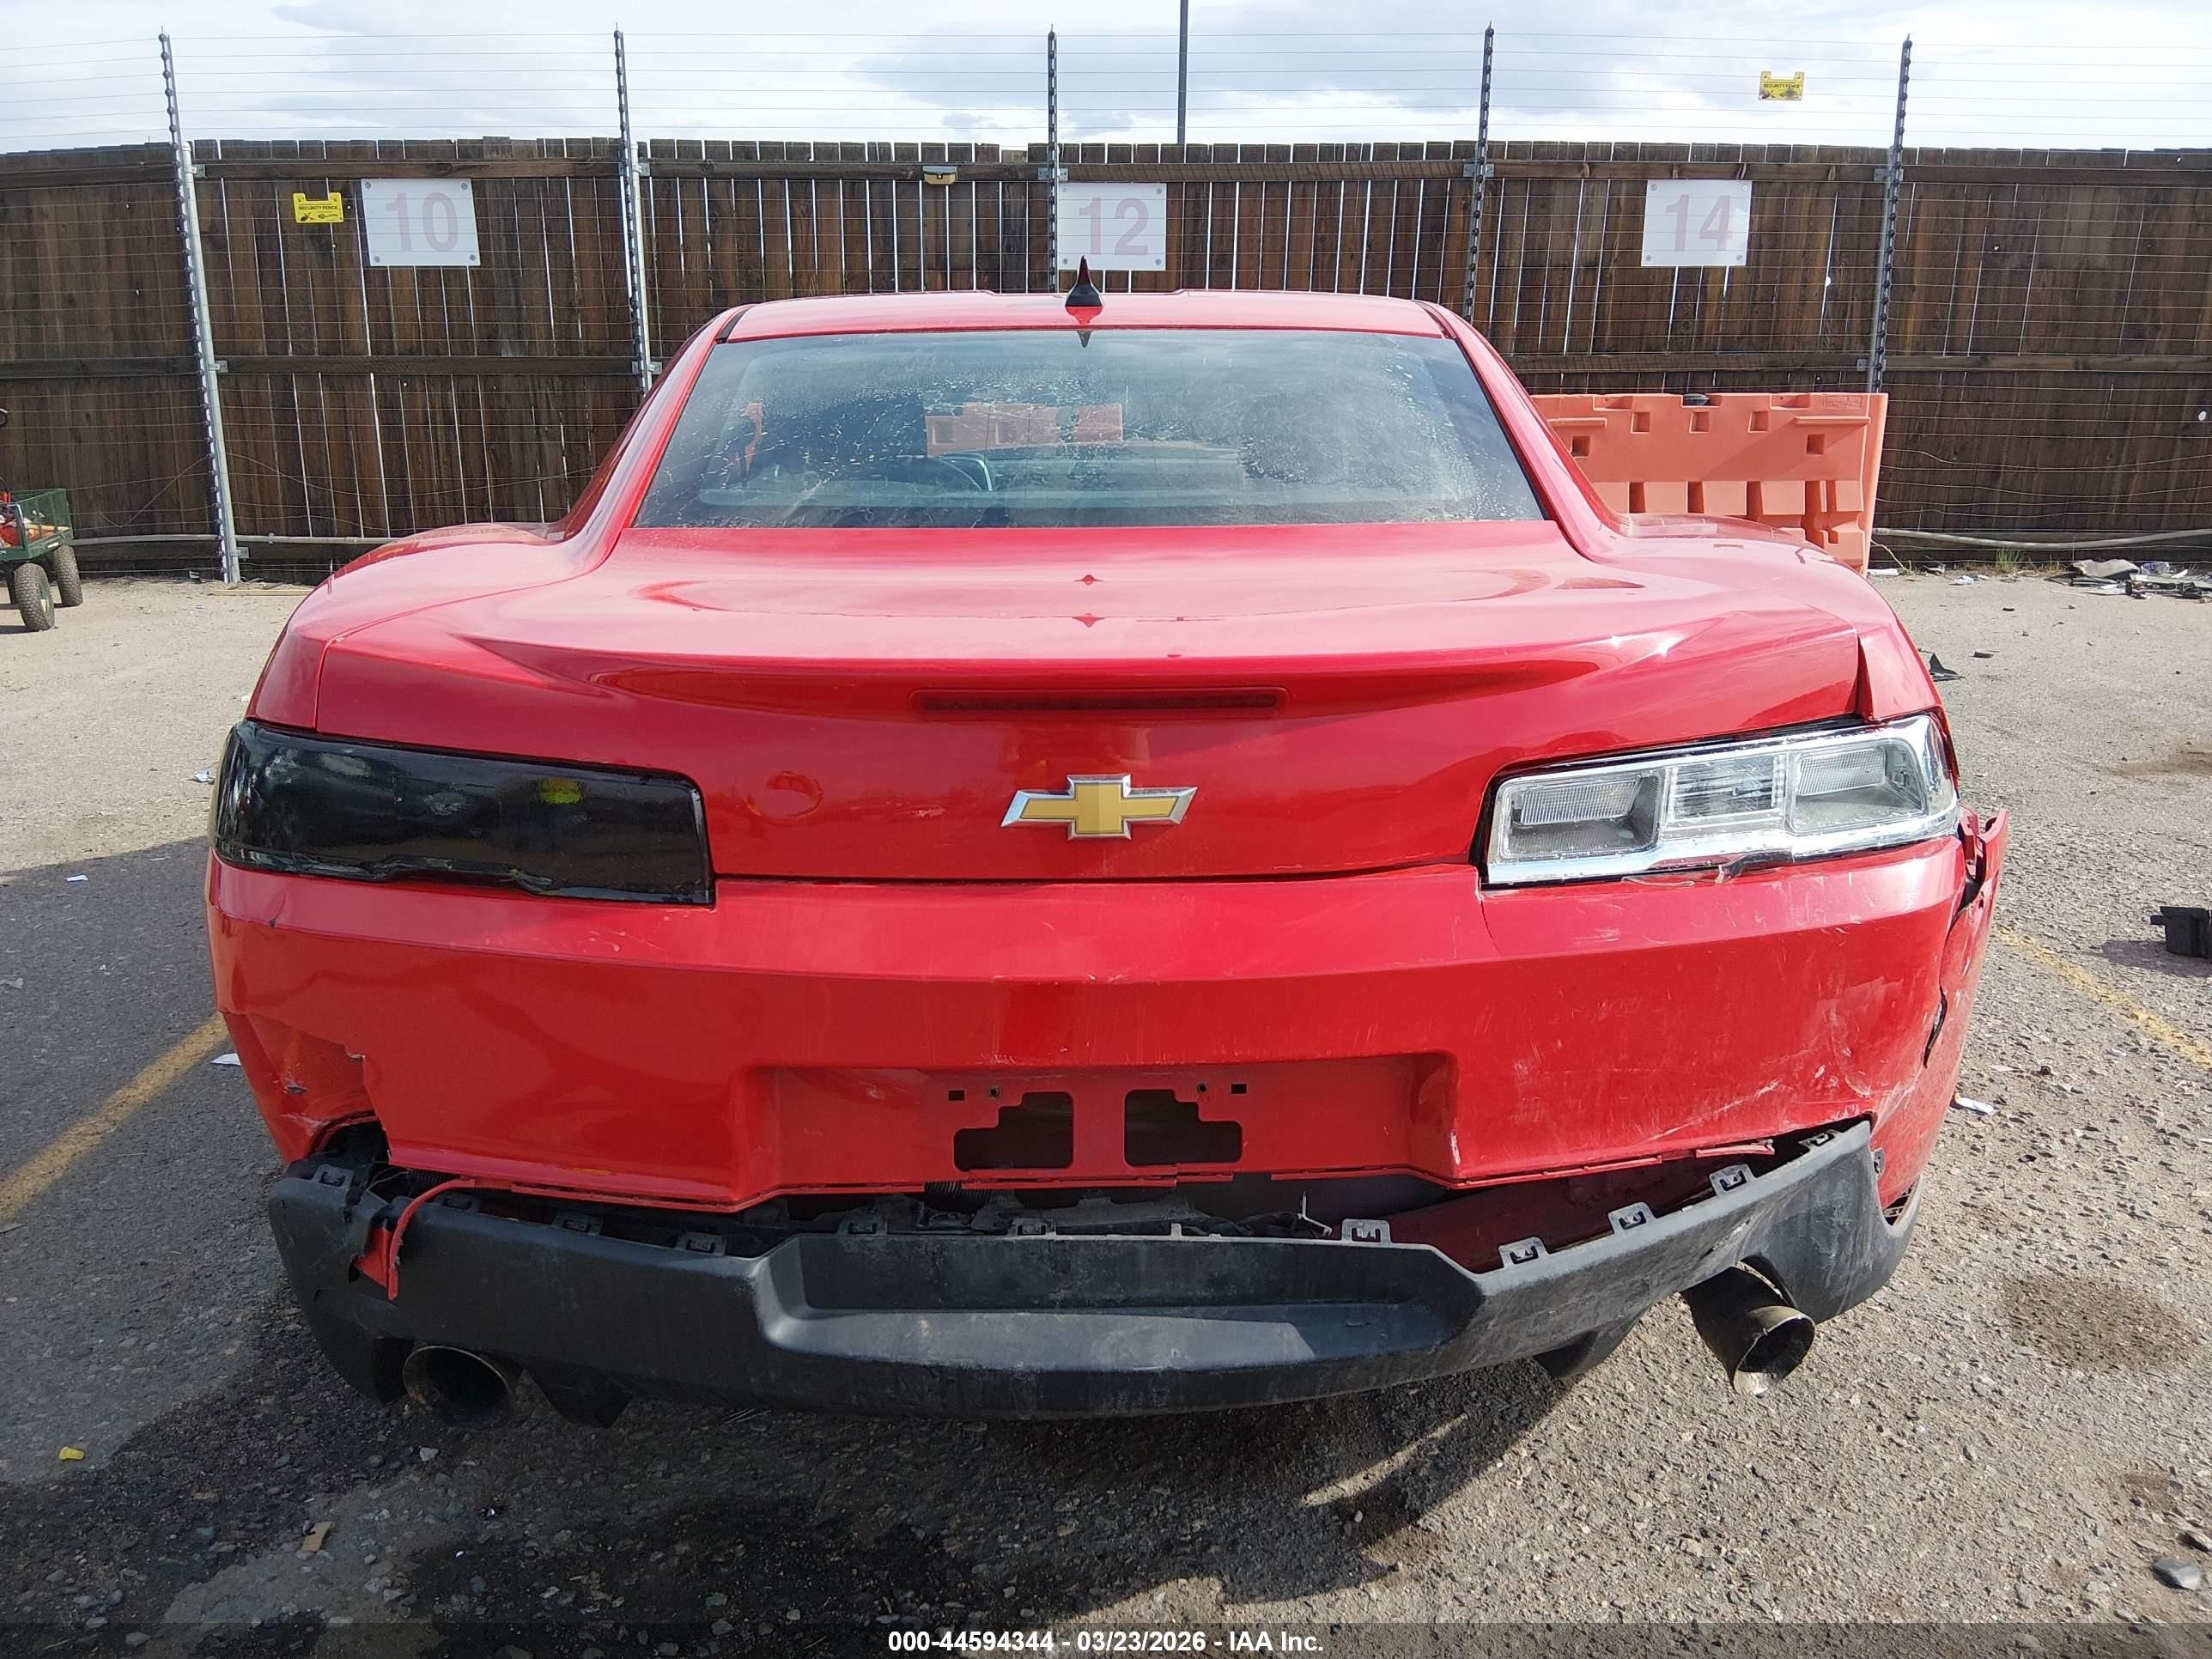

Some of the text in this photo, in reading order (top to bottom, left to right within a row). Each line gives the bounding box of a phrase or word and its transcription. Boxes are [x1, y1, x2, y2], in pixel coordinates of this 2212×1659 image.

[385, 191, 459, 252] 10
[1078, 197, 1149, 255] 12
[1666, 194, 1733, 252] 14
